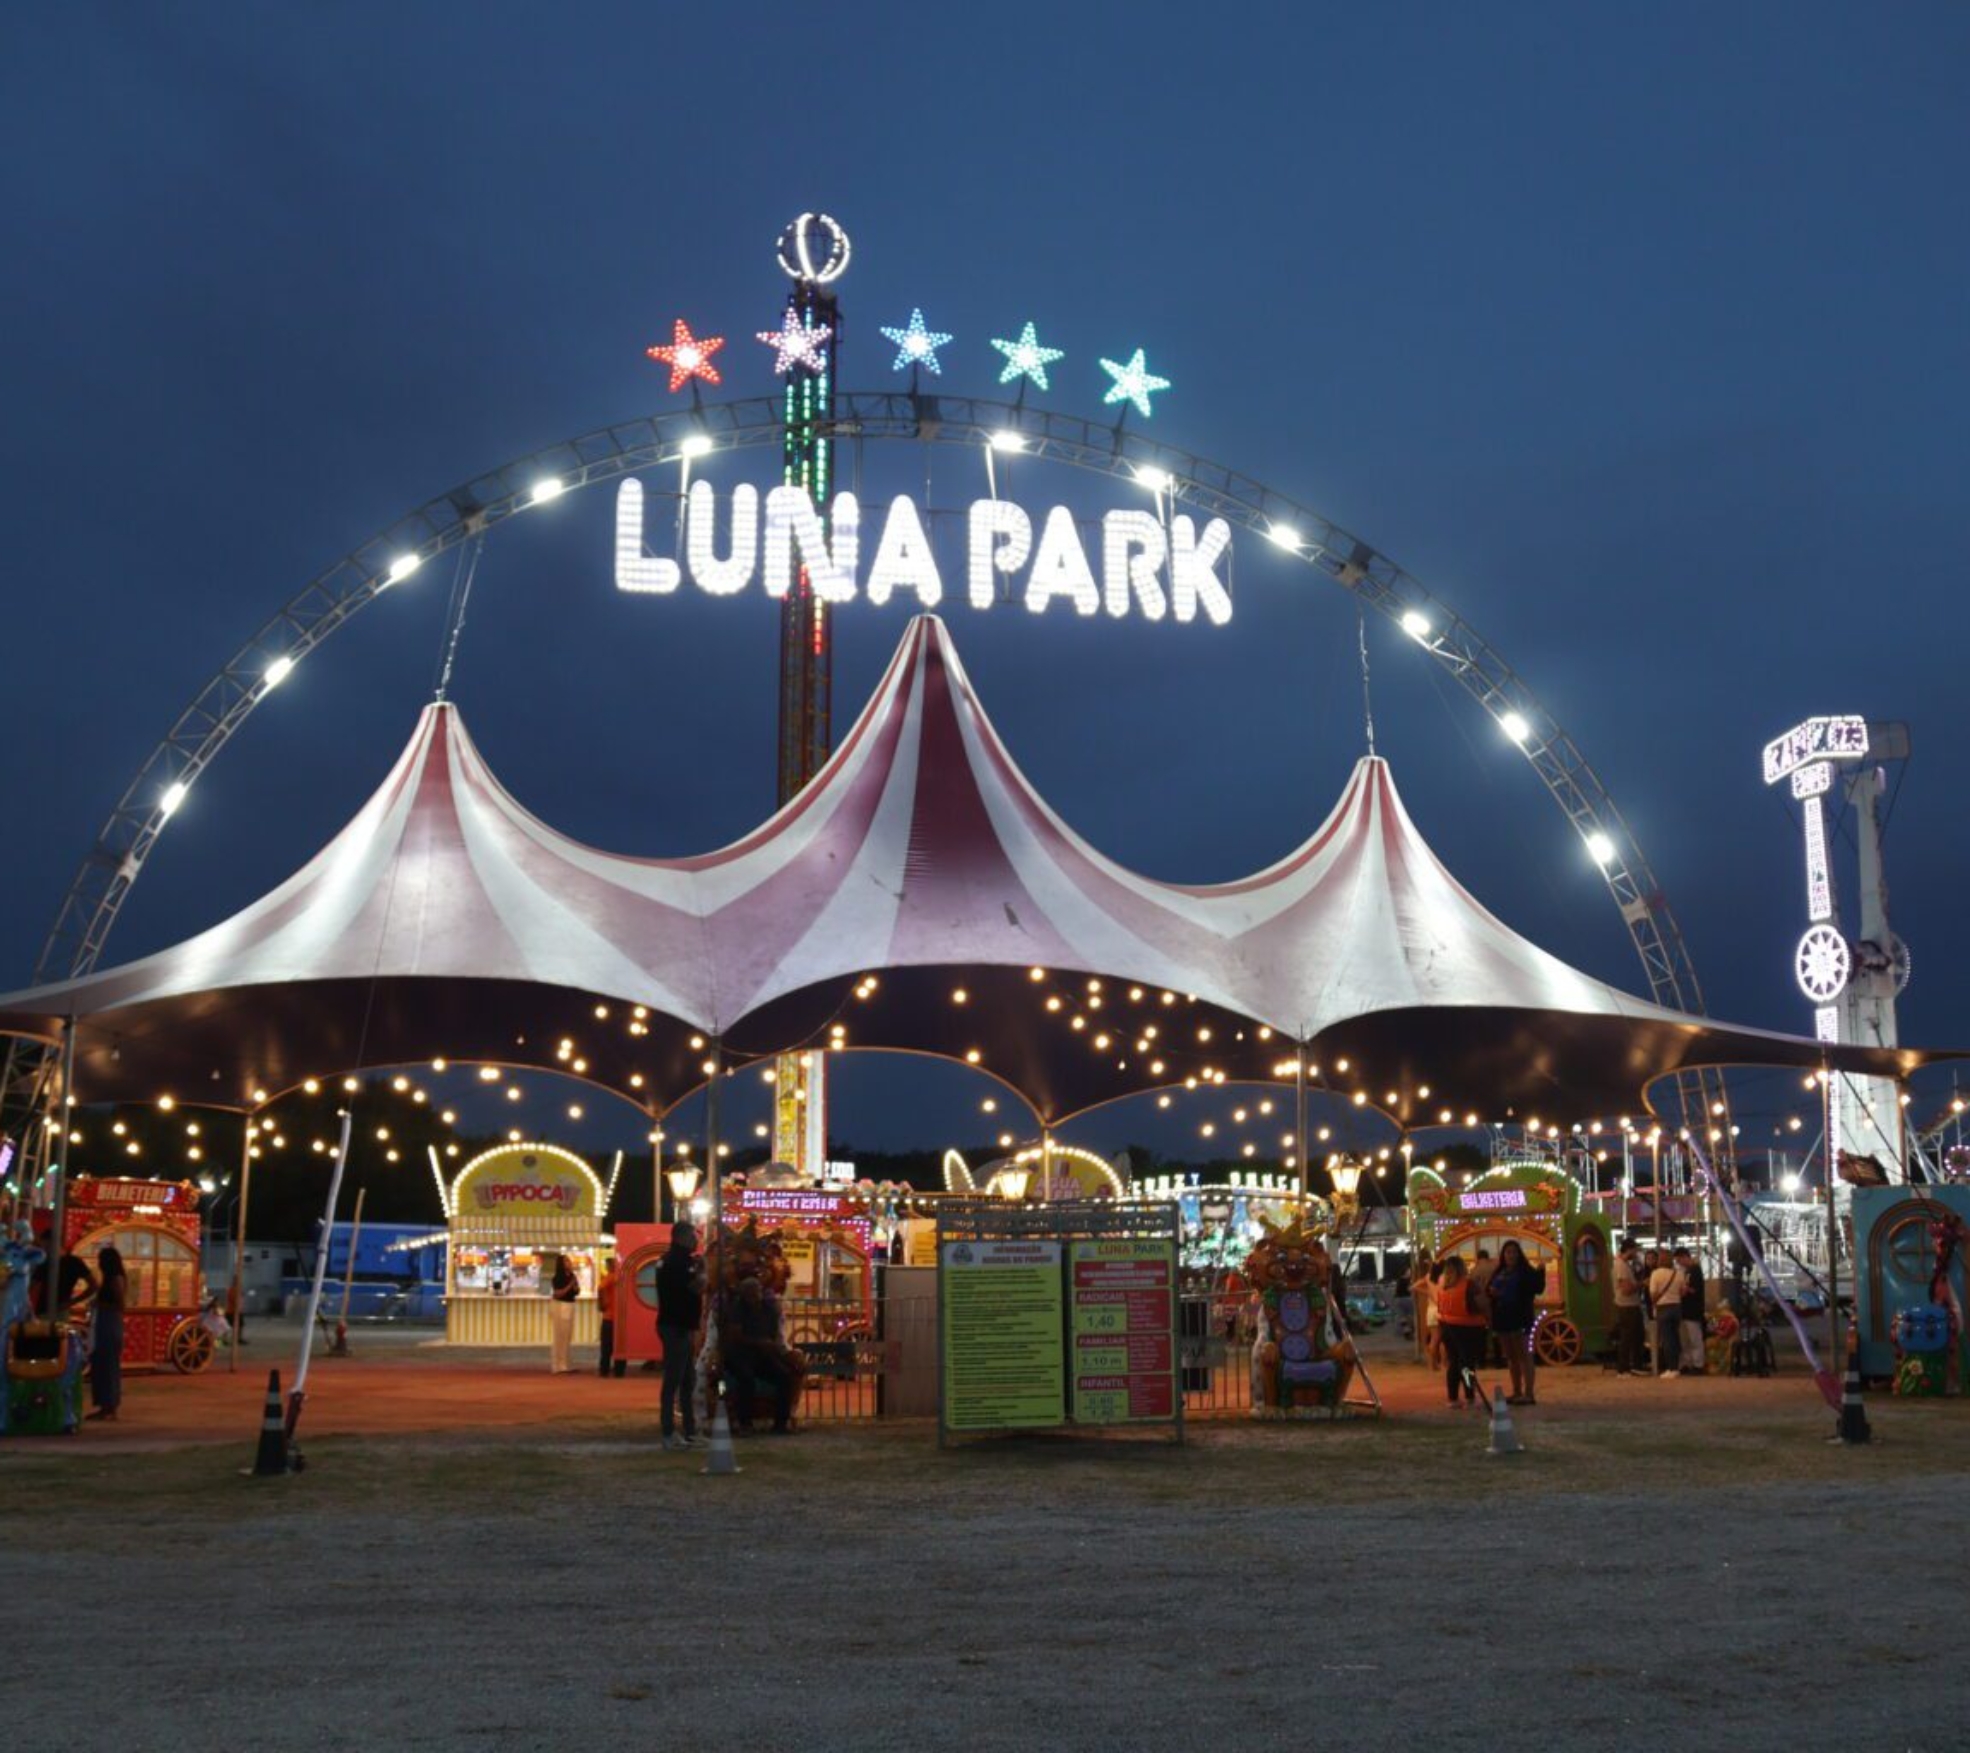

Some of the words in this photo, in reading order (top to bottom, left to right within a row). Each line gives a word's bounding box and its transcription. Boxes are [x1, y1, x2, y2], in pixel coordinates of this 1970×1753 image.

[615, 477, 943, 607] LUNA
[968, 499, 1234, 626] PARK
[491, 1183, 564, 1202] PIPOCA
[1098, 1244, 1130, 1255] LUNA
[1134, 1243, 1165, 1254] PARK
